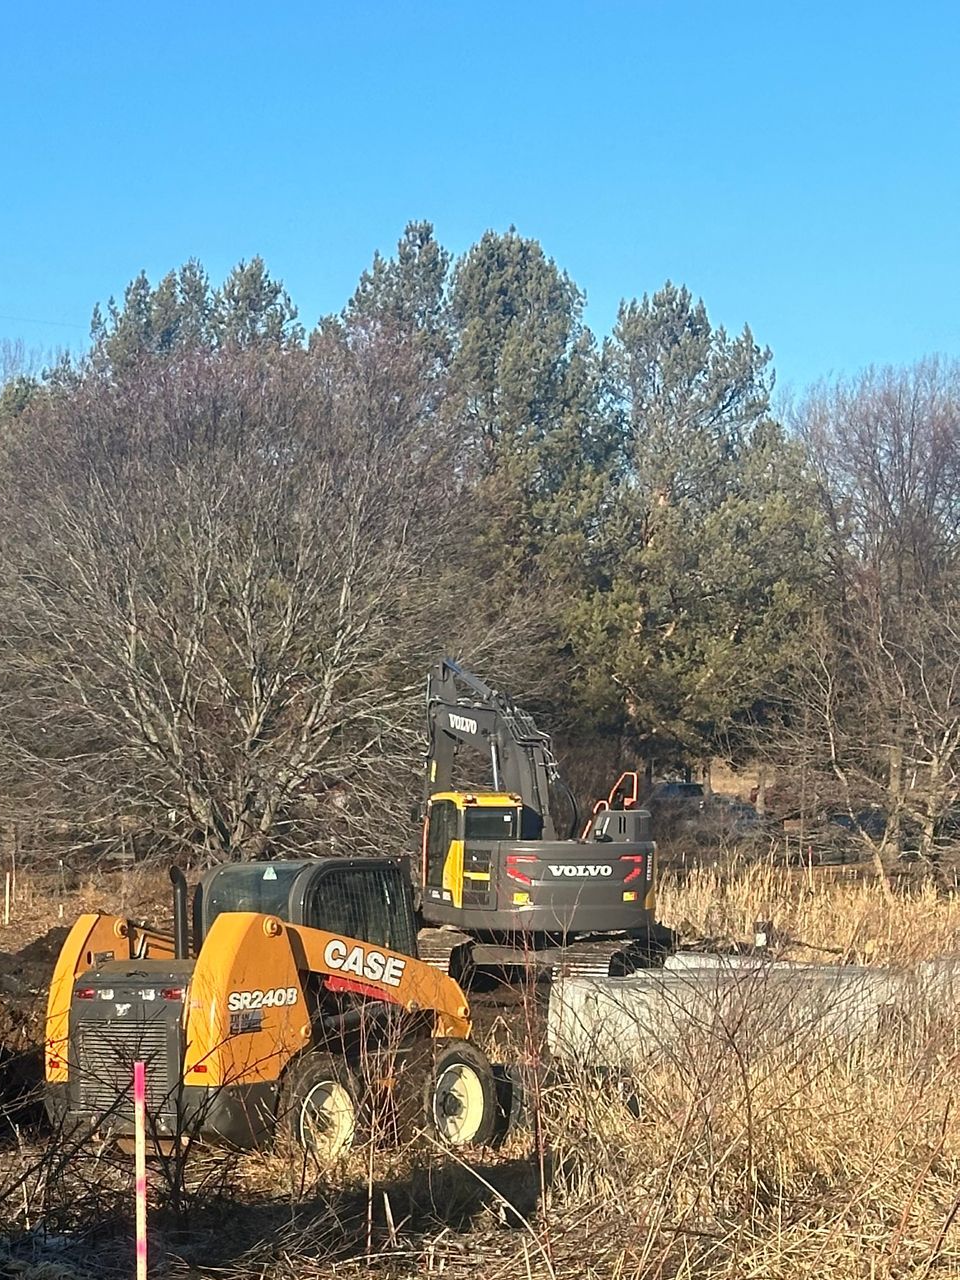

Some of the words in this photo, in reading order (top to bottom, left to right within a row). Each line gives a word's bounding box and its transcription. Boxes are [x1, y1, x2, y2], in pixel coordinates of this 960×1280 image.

[448, 713, 477, 734] VOLVO
[547, 865, 613, 877] VOLVO
[324, 940, 406, 987] CASE
[227, 988, 298, 1011] SR240B
